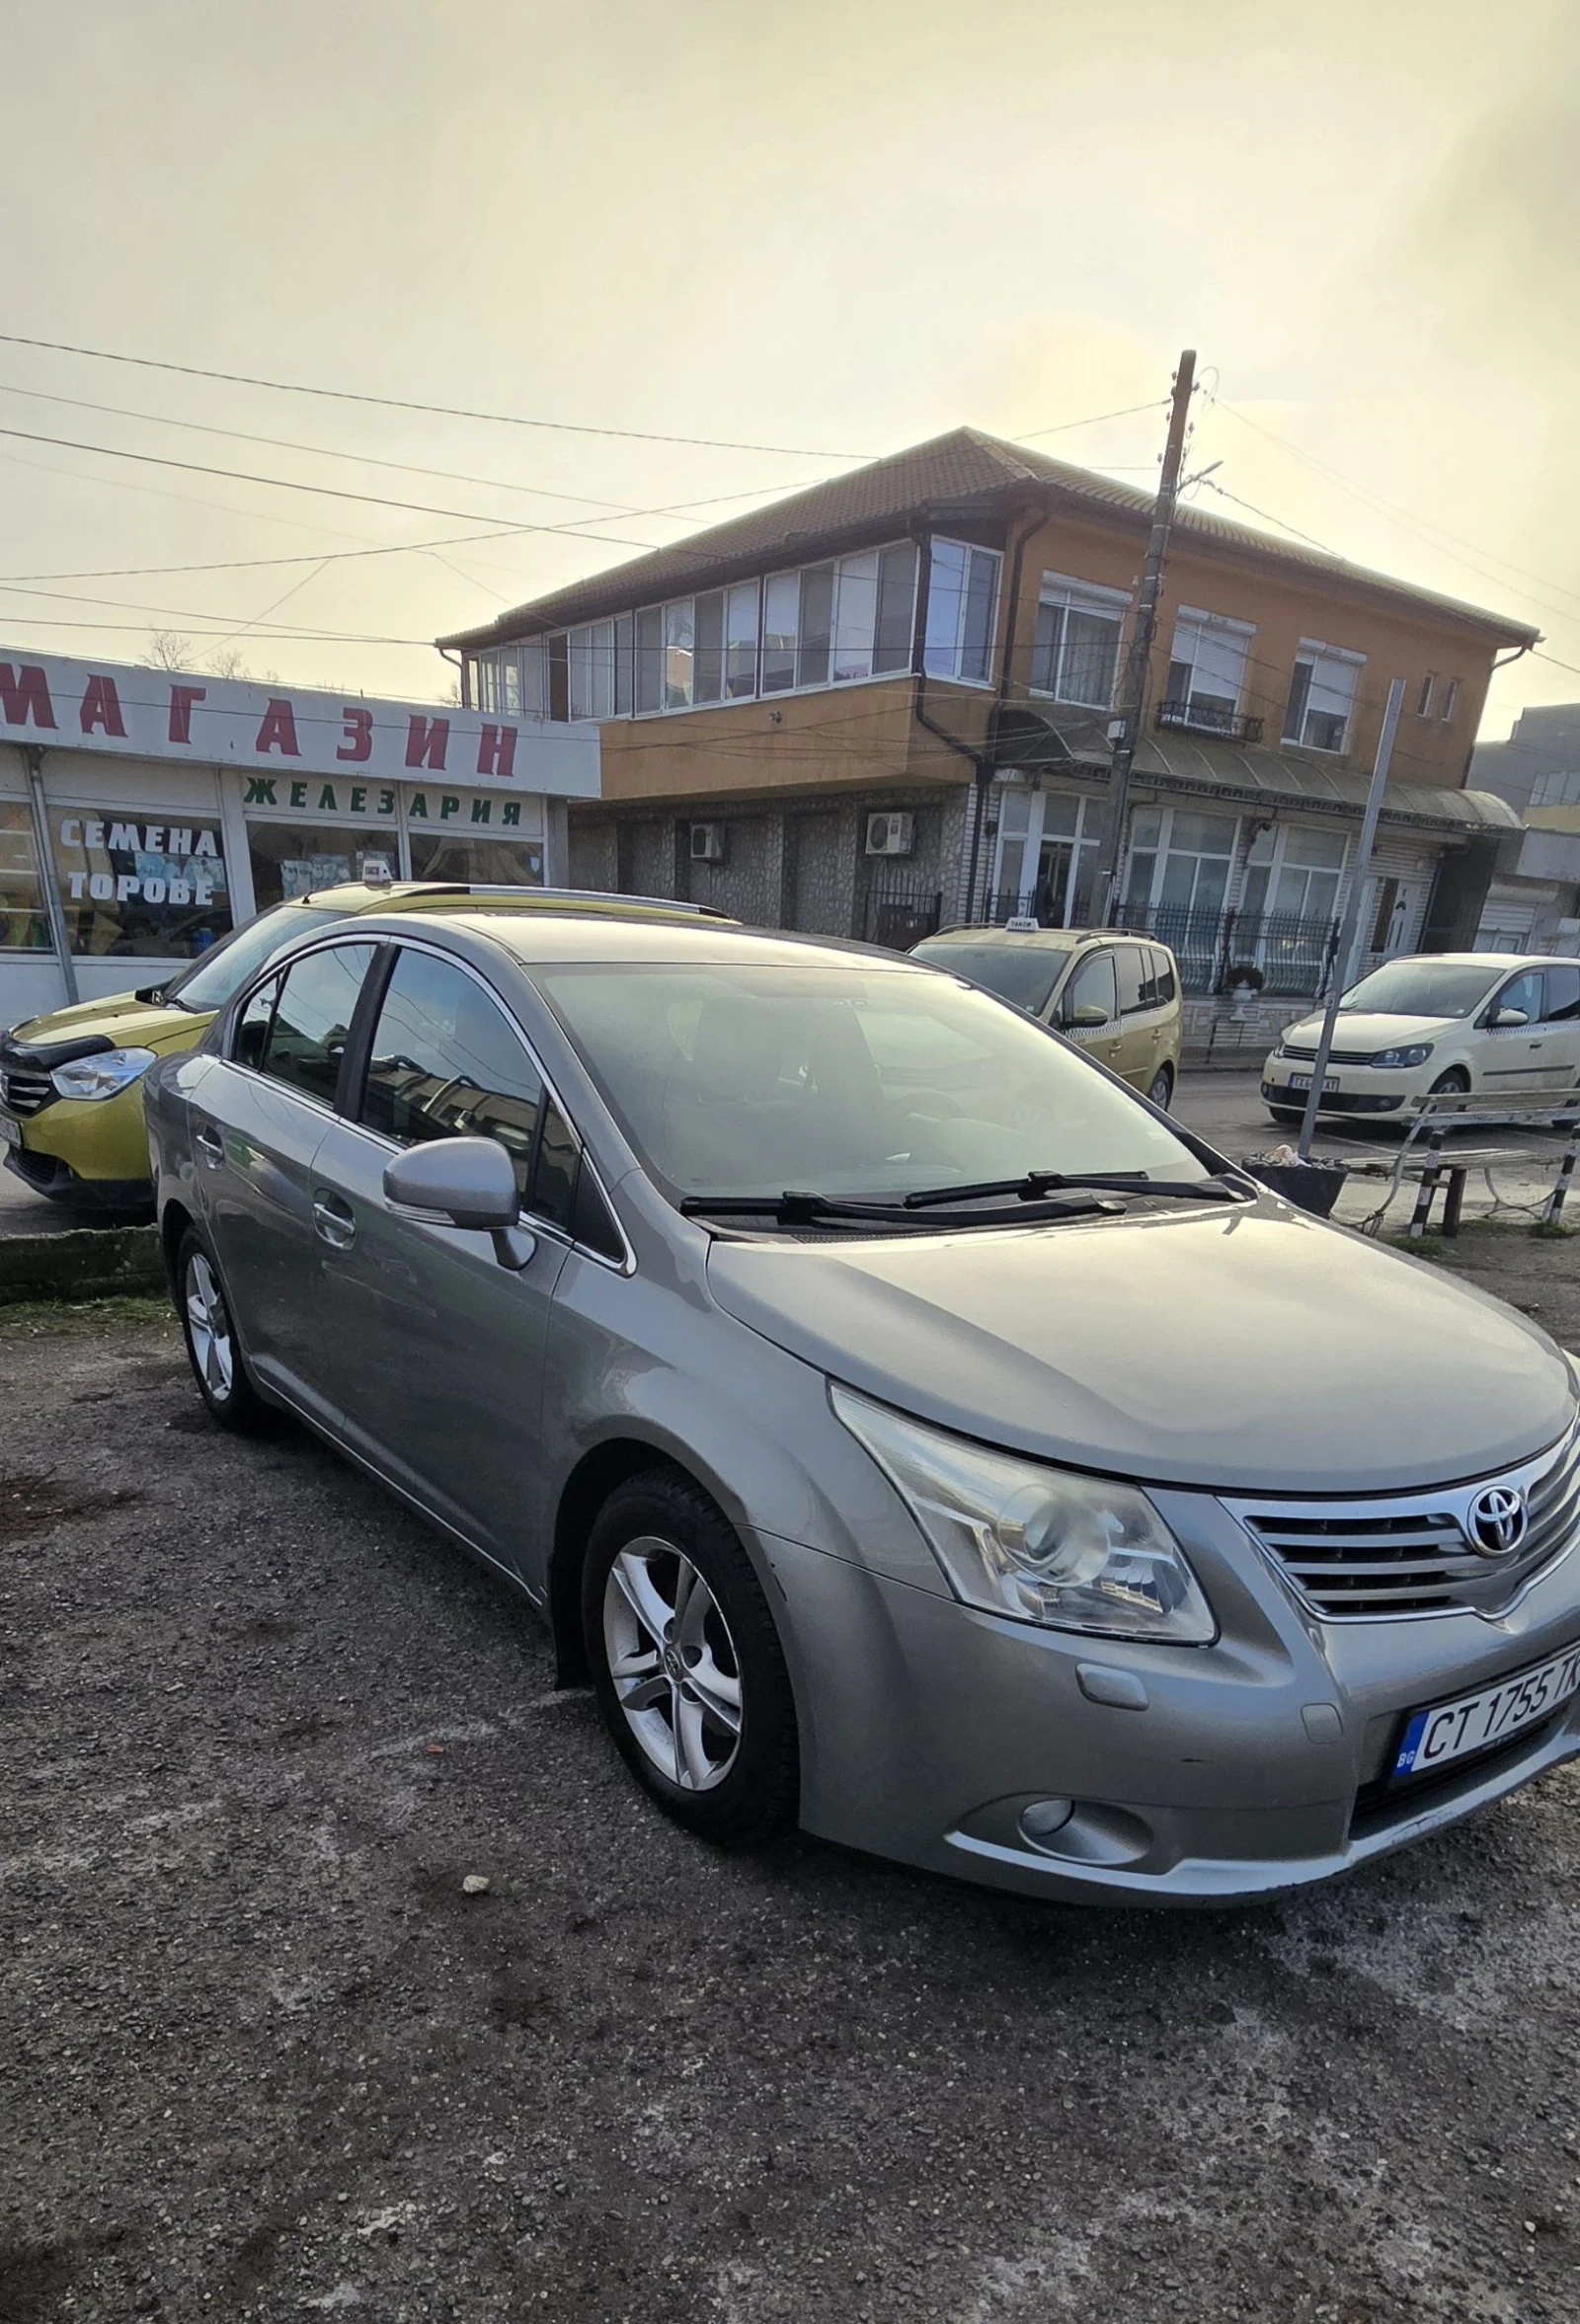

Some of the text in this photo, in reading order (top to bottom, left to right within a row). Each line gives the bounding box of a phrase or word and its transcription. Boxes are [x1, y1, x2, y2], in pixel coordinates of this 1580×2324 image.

[0, 662, 517, 777] МАГАЗИН
[243, 777, 521, 826] ЖЕЛЕЗАРИЯ
[60, 819, 218, 857] СЕМЕНА
[68, 871, 214, 906] ТОРОВЕ
[1423, 1701, 1480, 1759] CT
[1482, 1666, 1555, 1738] 1755
[1396, 1750, 1416, 1767] BG
